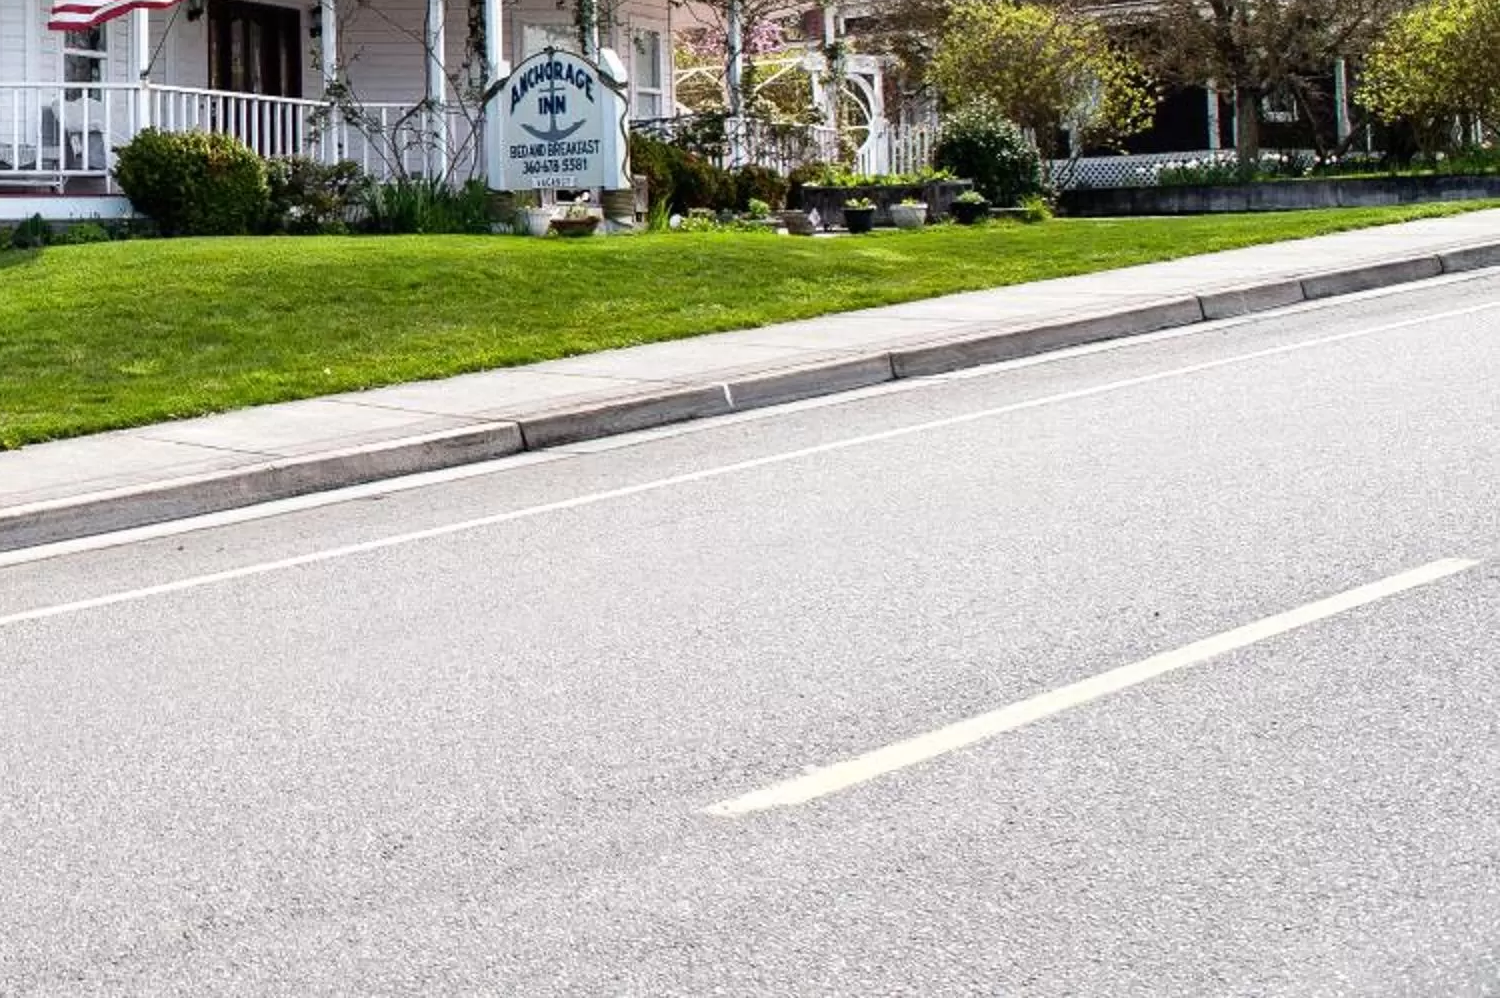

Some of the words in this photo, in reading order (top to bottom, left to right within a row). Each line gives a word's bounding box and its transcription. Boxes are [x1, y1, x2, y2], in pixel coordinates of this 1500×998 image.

[511, 62, 594, 115] ANCHORAGE
[538, 96, 566, 114] INN
[509, 145, 528, 158] BED
[529, 143, 546, 156] AND
[547, 140, 600, 156] BREAKFAST
